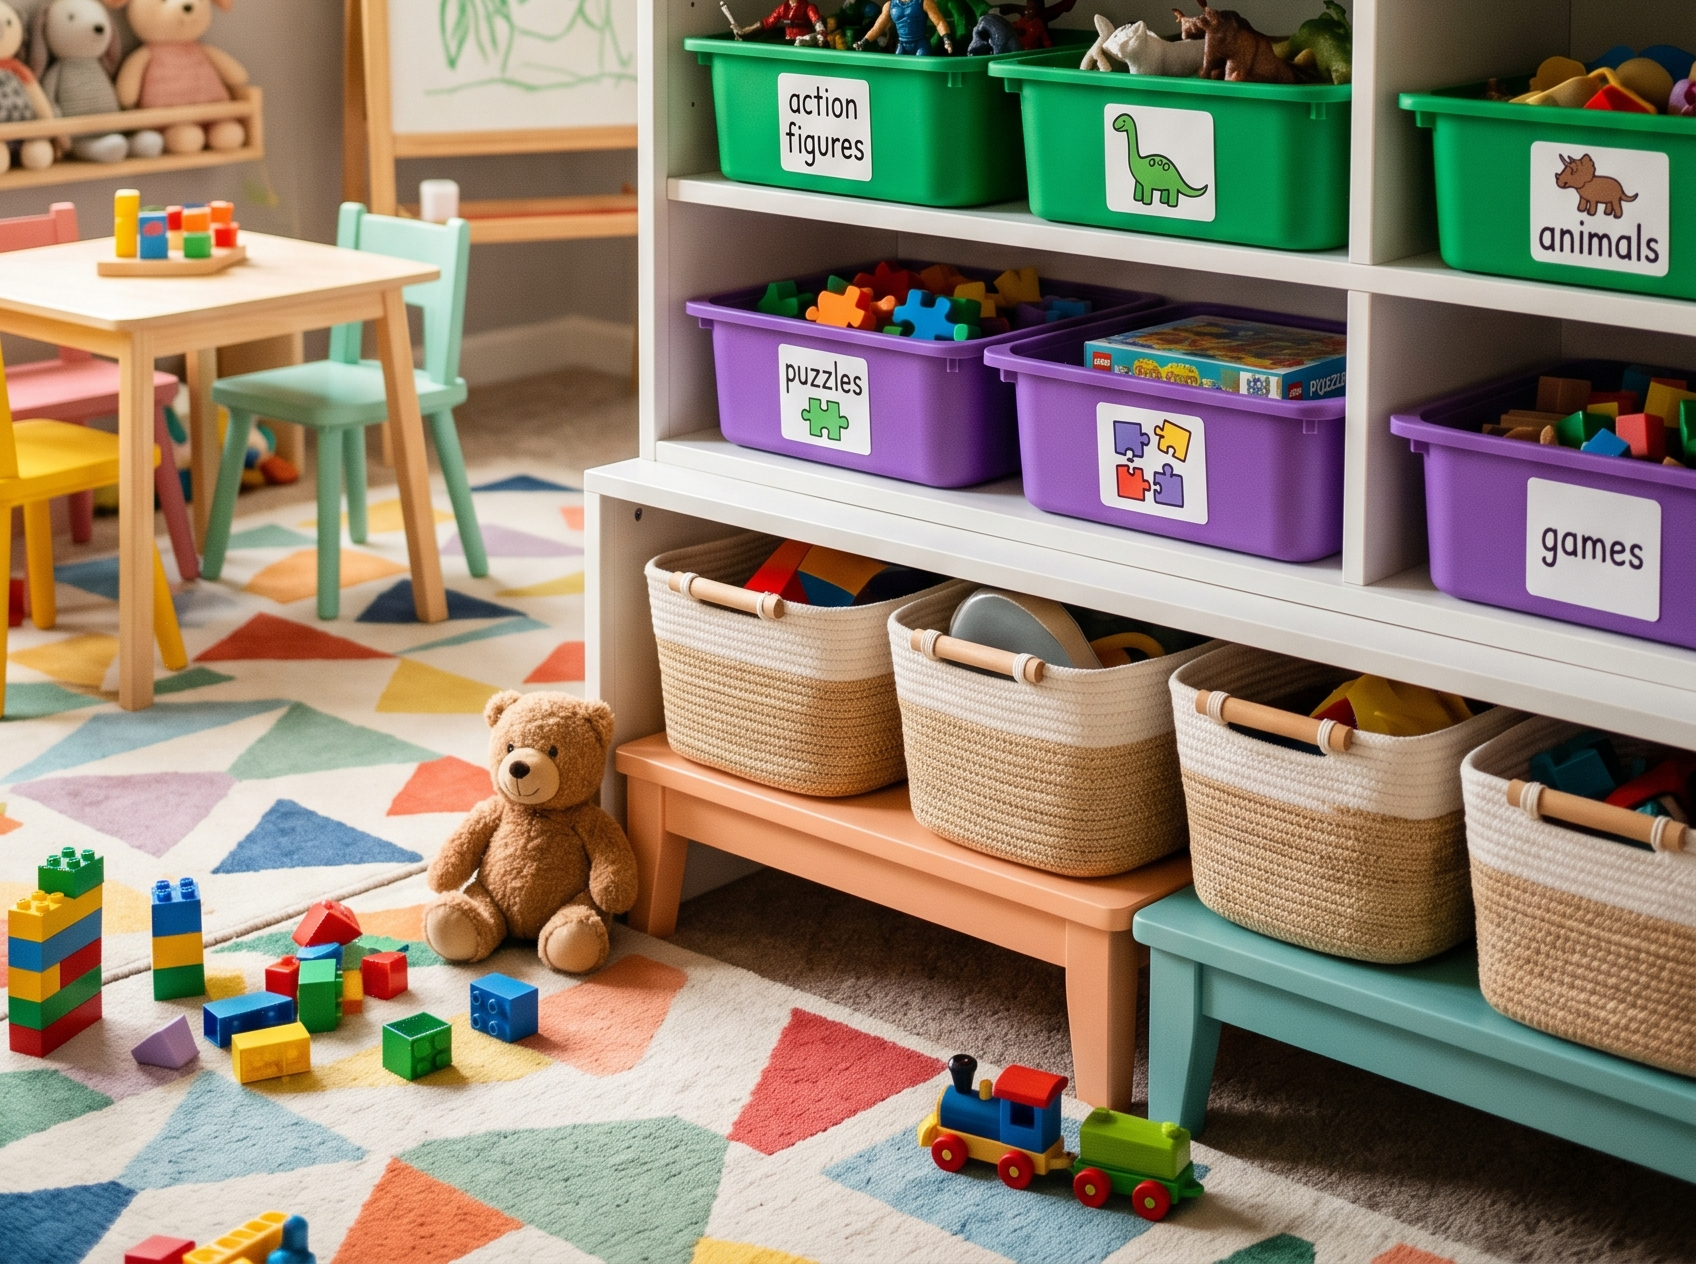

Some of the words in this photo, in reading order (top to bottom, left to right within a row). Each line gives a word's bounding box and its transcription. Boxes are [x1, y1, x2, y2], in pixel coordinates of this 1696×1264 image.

[789, 86, 858, 120] action
[785, 121, 865, 167] figures
[1538, 220, 1660, 264] animals
[785, 360, 863, 396] puzzles
[1541, 527, 1644, 571] games
